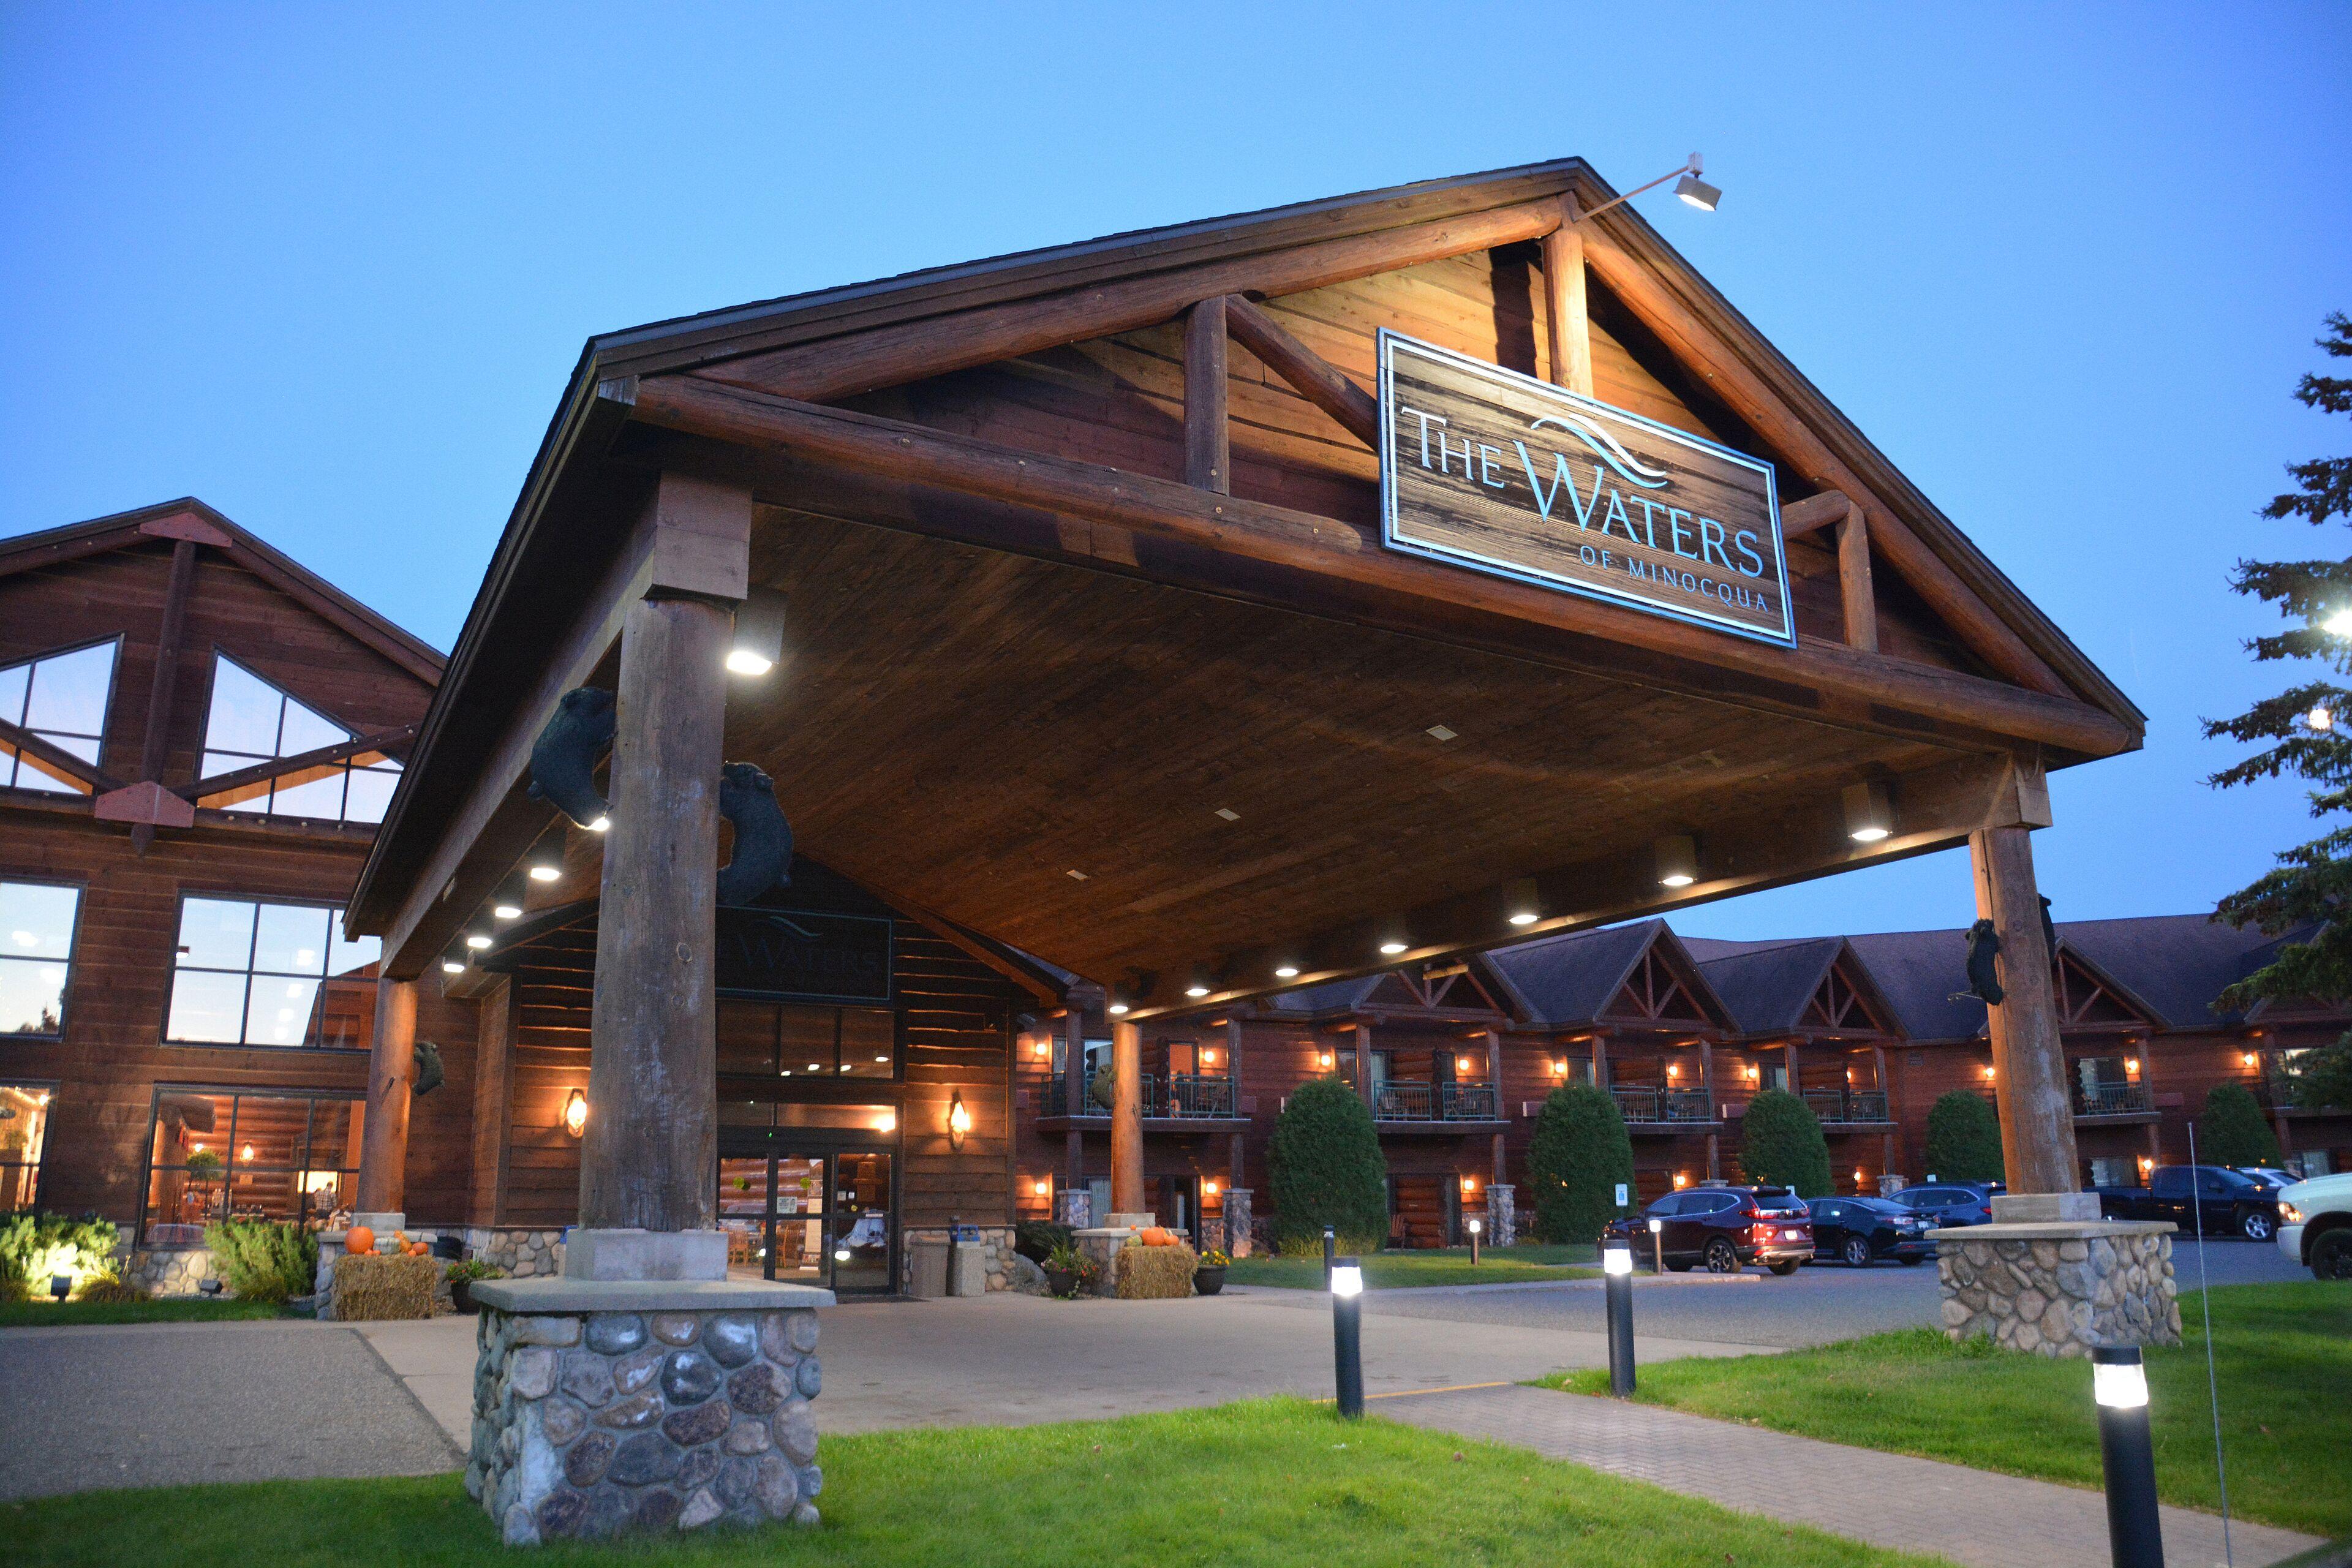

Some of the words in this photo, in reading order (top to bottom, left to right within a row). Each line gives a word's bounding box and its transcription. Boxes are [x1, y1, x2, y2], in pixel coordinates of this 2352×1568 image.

[1401, 407, 1505, 489] THE
[1513, 439, 1764, 578] WATERS
[1580, 545, 1612, 570] OF
[1627, 557, 1769, 612] MINOCQUA
[736, 935, 880, 974] WATERS
